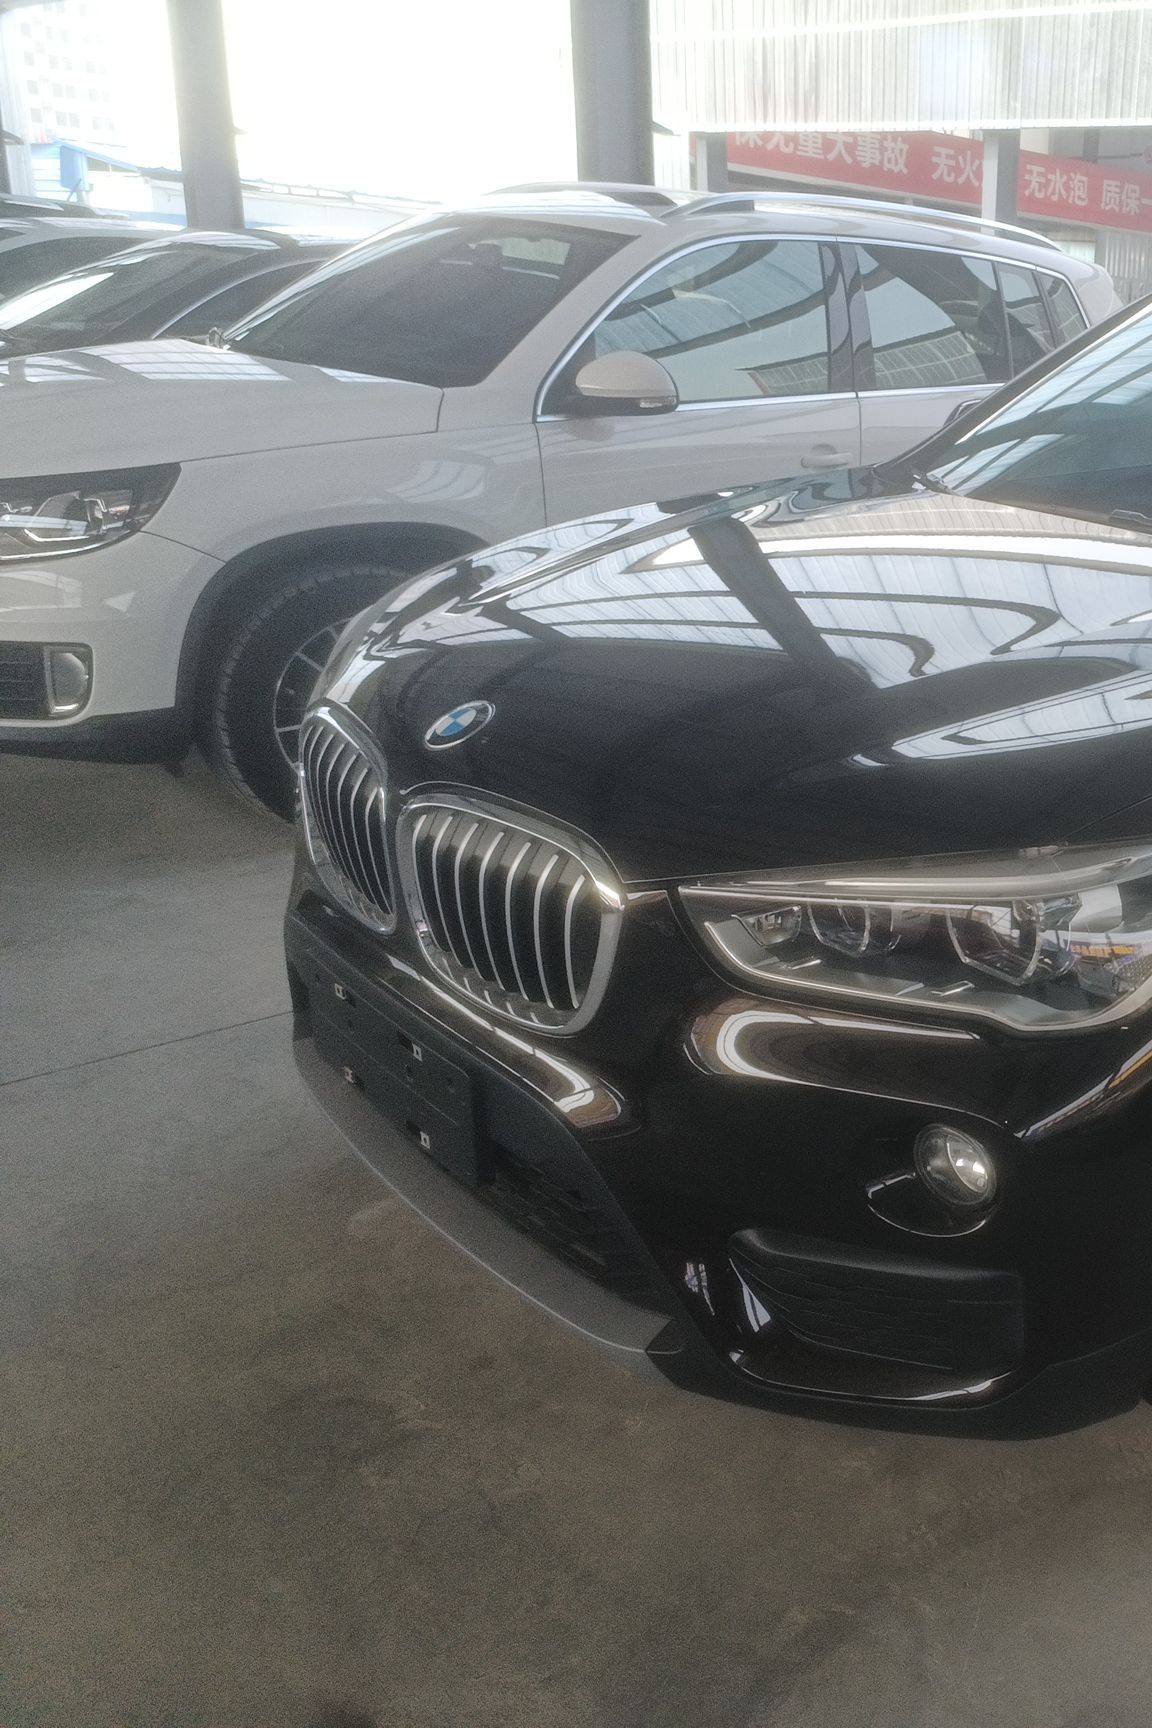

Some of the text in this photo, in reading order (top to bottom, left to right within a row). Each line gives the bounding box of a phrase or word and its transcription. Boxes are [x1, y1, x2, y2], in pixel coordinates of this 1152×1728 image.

[931, 146, 983, 188] 无火
[1024, 164, 1088, 206] 无水泡
